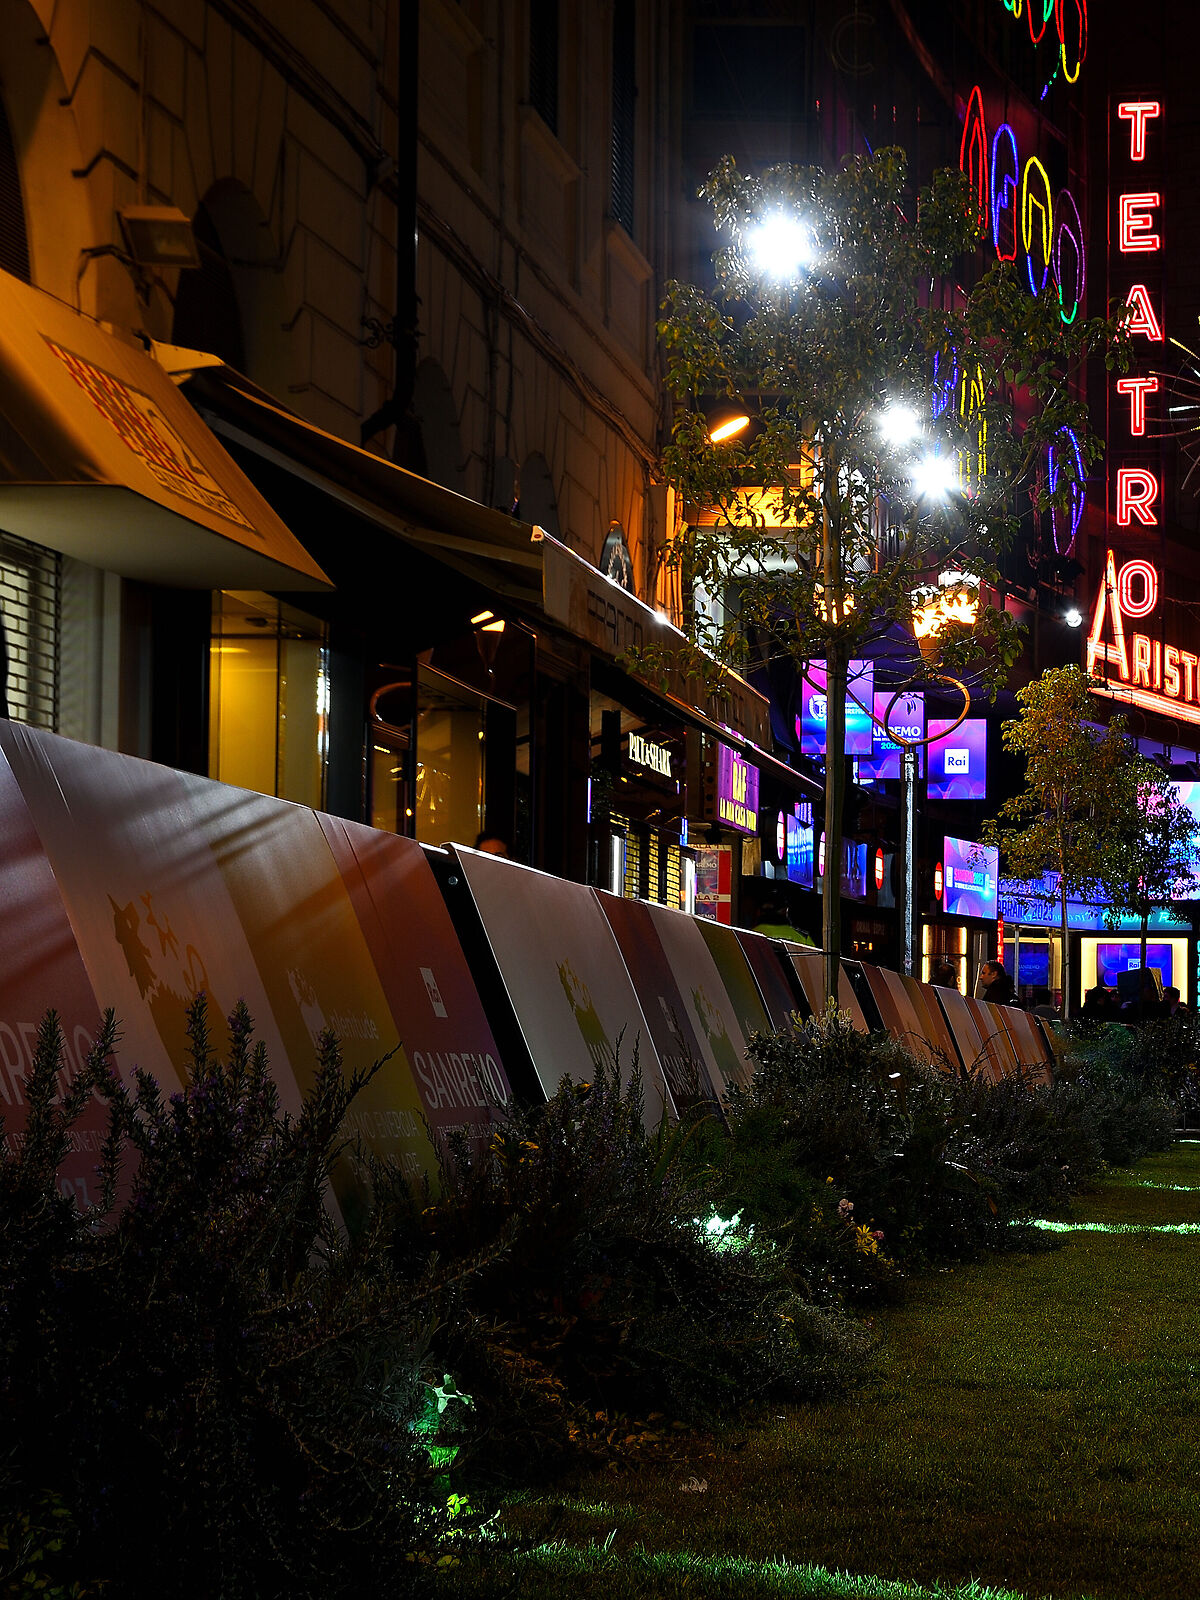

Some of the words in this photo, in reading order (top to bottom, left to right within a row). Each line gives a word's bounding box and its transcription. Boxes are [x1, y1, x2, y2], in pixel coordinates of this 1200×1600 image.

[1117, 101, 1163, 618] TEATRO
[873, 726, 921, 737] ANEMO
[948, 751, 966, 766] Rai
[413, 1052, 510, 1110] SANREMO
